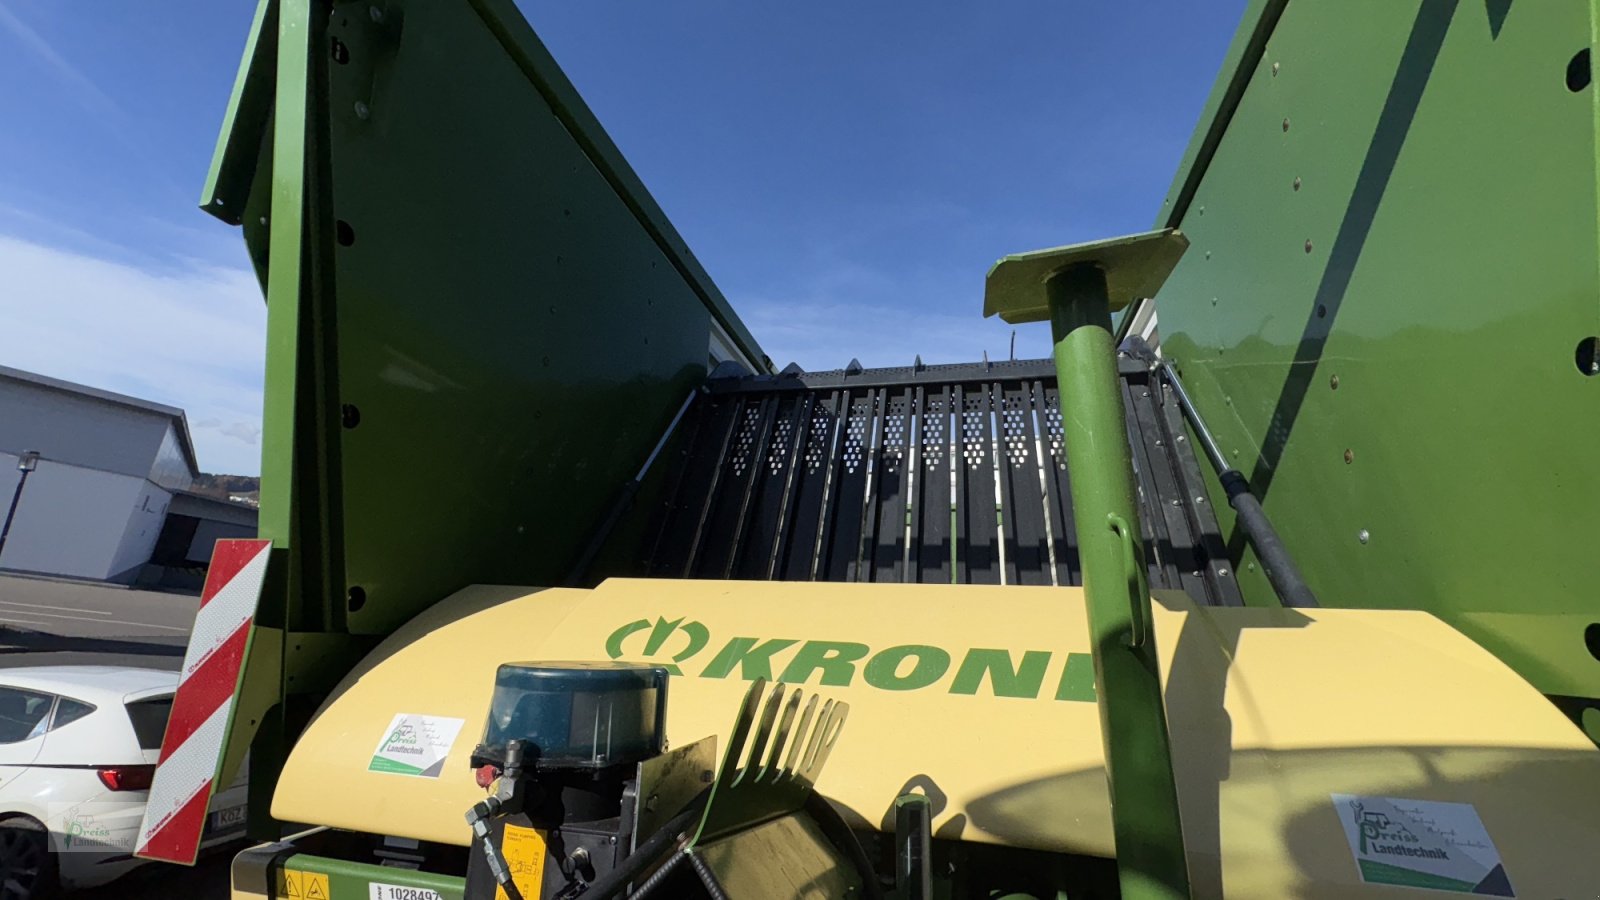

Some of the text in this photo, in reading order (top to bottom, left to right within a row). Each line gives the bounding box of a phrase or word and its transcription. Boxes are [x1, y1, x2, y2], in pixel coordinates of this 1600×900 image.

[387, 745, 424, 755] Landtechnik
[1359, 820, 1419, 855] Preiss
[1371, 842, 1450, 860] Landtechnik
